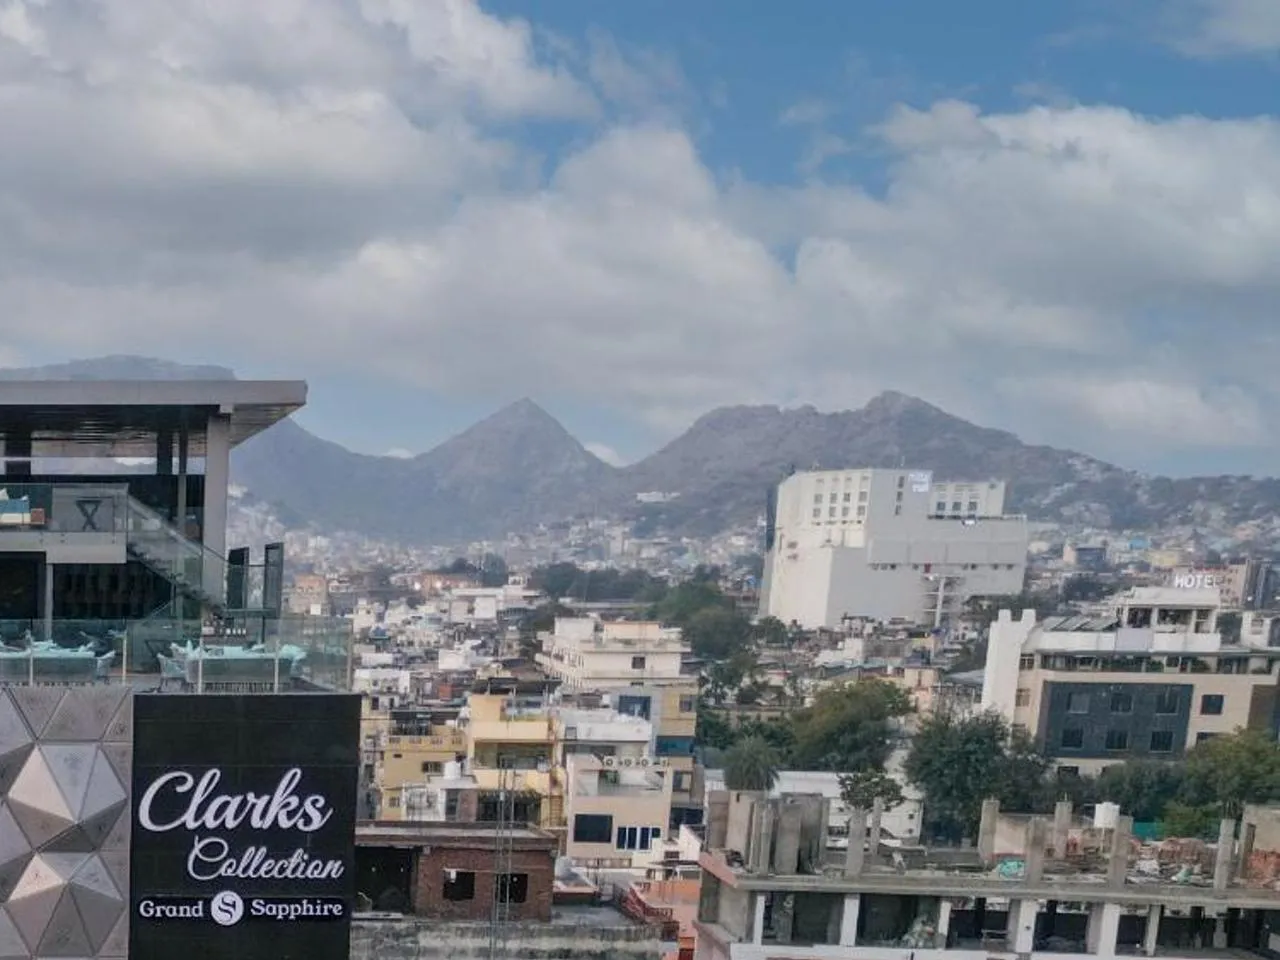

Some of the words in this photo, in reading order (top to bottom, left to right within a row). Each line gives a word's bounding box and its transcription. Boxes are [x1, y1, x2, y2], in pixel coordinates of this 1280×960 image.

[138, 768, 333, 831] Clarks
[187, 834, 345, 880] Collection
[139, 901, 203, 917] Grand
[250, 899, 343, 920] Sapphire
